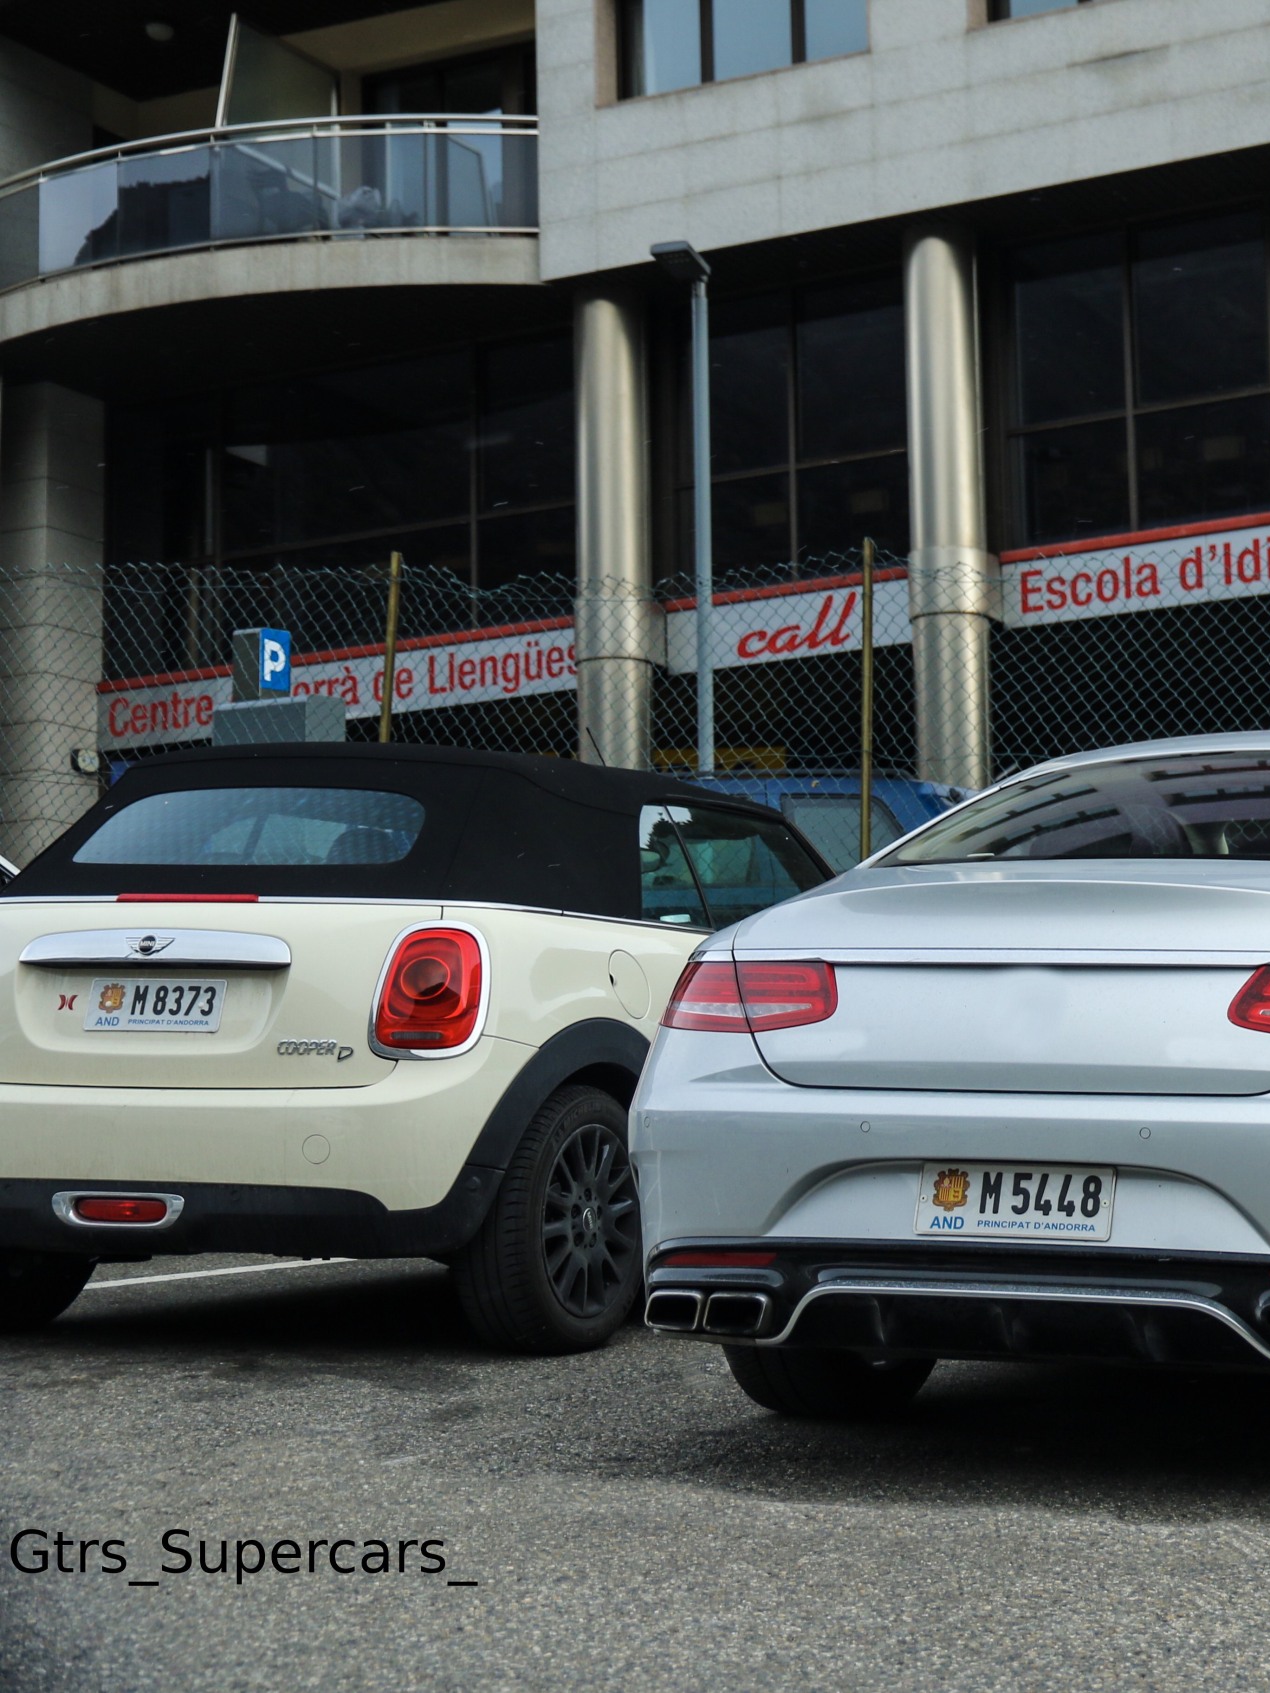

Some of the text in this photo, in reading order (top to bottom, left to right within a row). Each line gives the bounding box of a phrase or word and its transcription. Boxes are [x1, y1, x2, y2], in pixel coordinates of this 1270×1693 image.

[1020, 559, 1160, 615] Escola
[736, 591, 857, 659] call
[264, 638, 286, 682] P
[108, 691, 214, 738] Centre
[429, 640, 577, 695] Llengües
[95, 1016, 120, 1027] AND
[128, 1018, 164, 1026] PRINCIPAT
[152, 985, 217, 1017] 8373
[277, 1039, 338, 1056] COOPER
[1011, 1172, 1103, 1218] 5448
[930, 1215, 1096, 1232] AND PRINCIPAT D'ANDORRA
